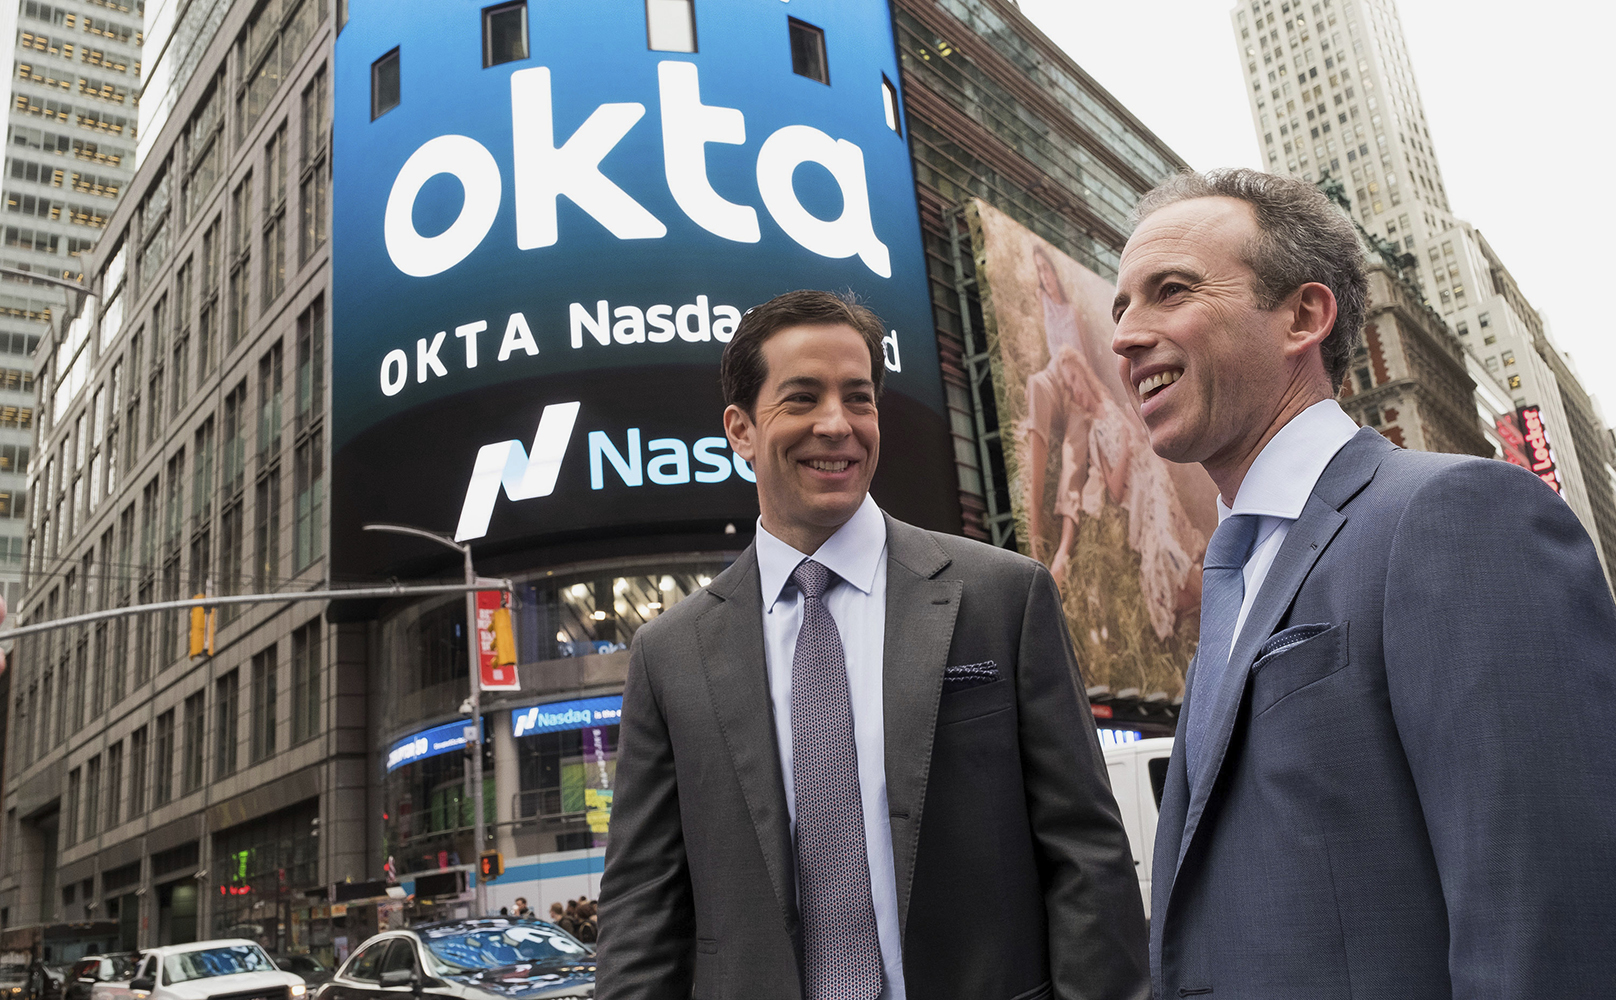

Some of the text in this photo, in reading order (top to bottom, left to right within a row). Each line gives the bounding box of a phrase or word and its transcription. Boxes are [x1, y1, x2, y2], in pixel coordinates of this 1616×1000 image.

[384, 60, 891, 279] okta
[380, 295, 754, 397] OKTA Nasda
[587, 428, 757, 490] Nas
[1522, 408, 1552, 472] Locker
[538, 708, 591, 727] Nasdaq
